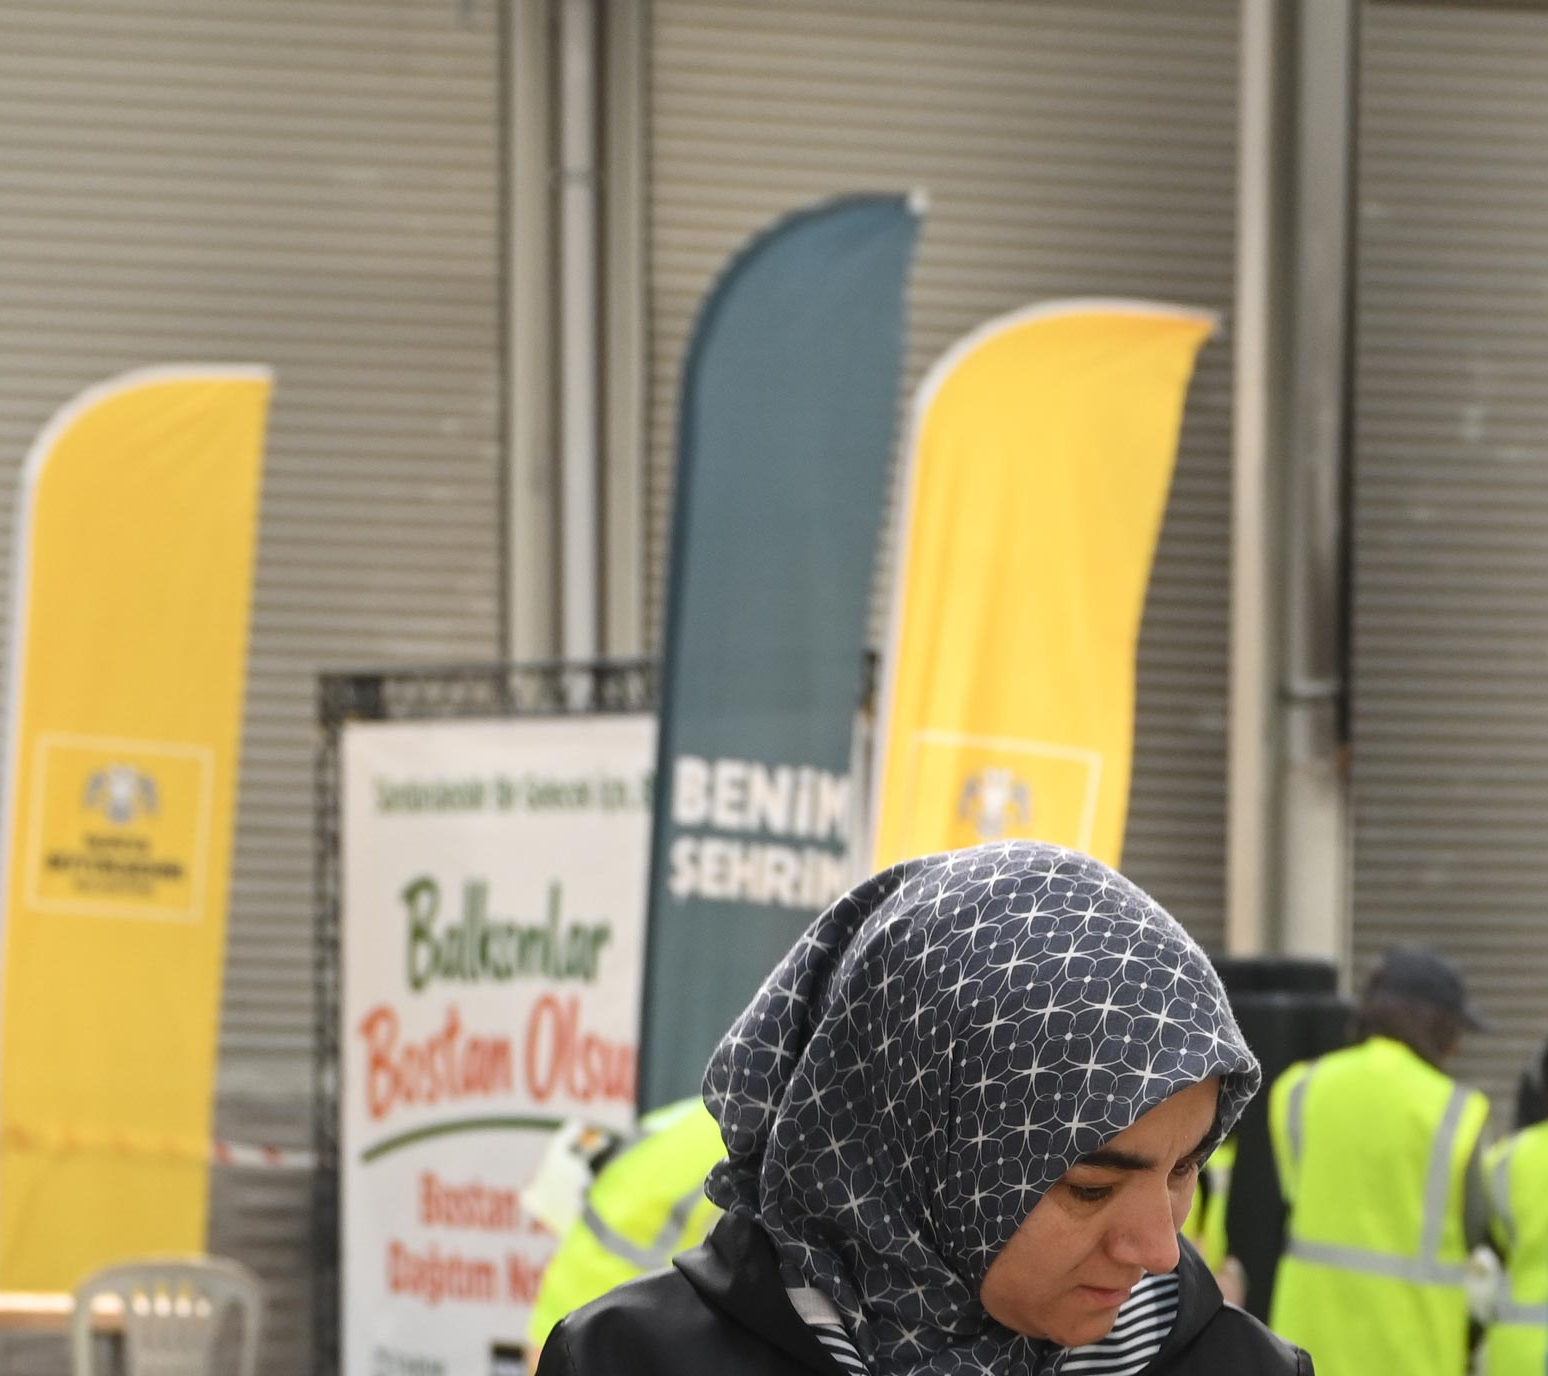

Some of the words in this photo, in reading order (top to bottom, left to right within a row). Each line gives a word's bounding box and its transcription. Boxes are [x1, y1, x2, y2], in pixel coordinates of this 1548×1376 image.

[401, 874, 611, 991] Balkonlar
[359, 1003, 514, 1118] Bostan
[525, 992, 638, 1104] Olsu
